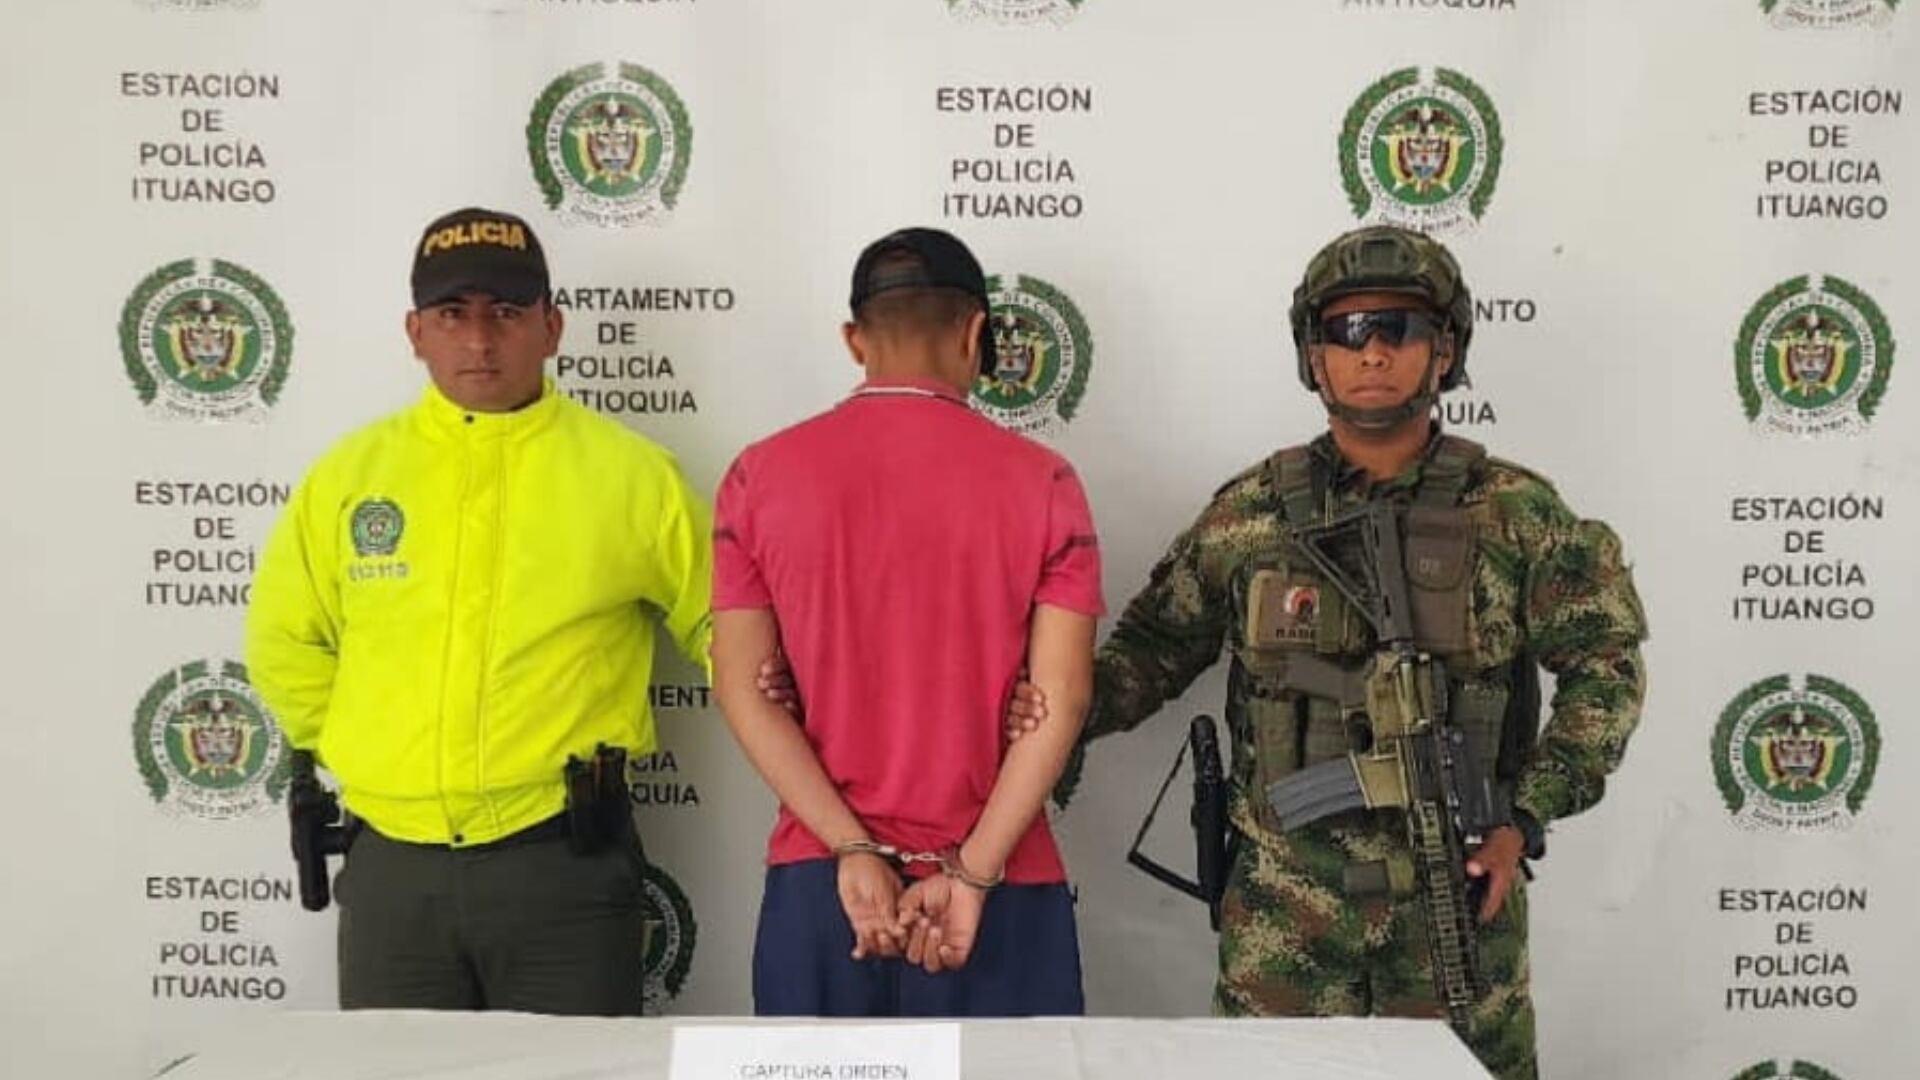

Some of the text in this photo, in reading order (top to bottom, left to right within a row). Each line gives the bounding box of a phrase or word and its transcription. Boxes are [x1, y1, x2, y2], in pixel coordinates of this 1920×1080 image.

[121, 70, 279, 98] ESTACIÓN
[937, 83, 1091, 112] ESTACIÓN
[1749, 86, 1902, 115] ESTACIÓN
[182, 109, 224, 132] DE
[995, 124, 1034, 148] DE
[1809, 125, 1848, 148] DE
[133, 177, 275, 204] ITUANGO
[944, 193, 1083, 218] ITUANGO
[1757, 194, 1888, 219] ITUANGO
[423, 221, 527, 257] POLICIA
[551, 287, 735, 311] ARTAMENTO
[598, 322, 636, 345] DE
[567, 389, 698, 413] TIOQUIA
[1732, 492, 1883, 521] ESTACIÓN
[194, 517, 236, 540] DE
[1784, 530, 1825, 554] DE
[153, 546, 256, 574] POLICÍ
[146, 582, 252, 607] ITUAN
[1734, 596, 1875, 620] ITUANGO
[146, 872, 293, 901] ESTACIÓN
[1719, 884, 1867, 912] ESTACIÓN
[201, 911, 240, 934] DE
[1776, 922, 1814, 945] DE
[153, 975, 287, 1000] ITUANGO
[1725, 985, 1858, 1010] ITUANGO
[740, 1063, 833, 1080] CAPTURA
